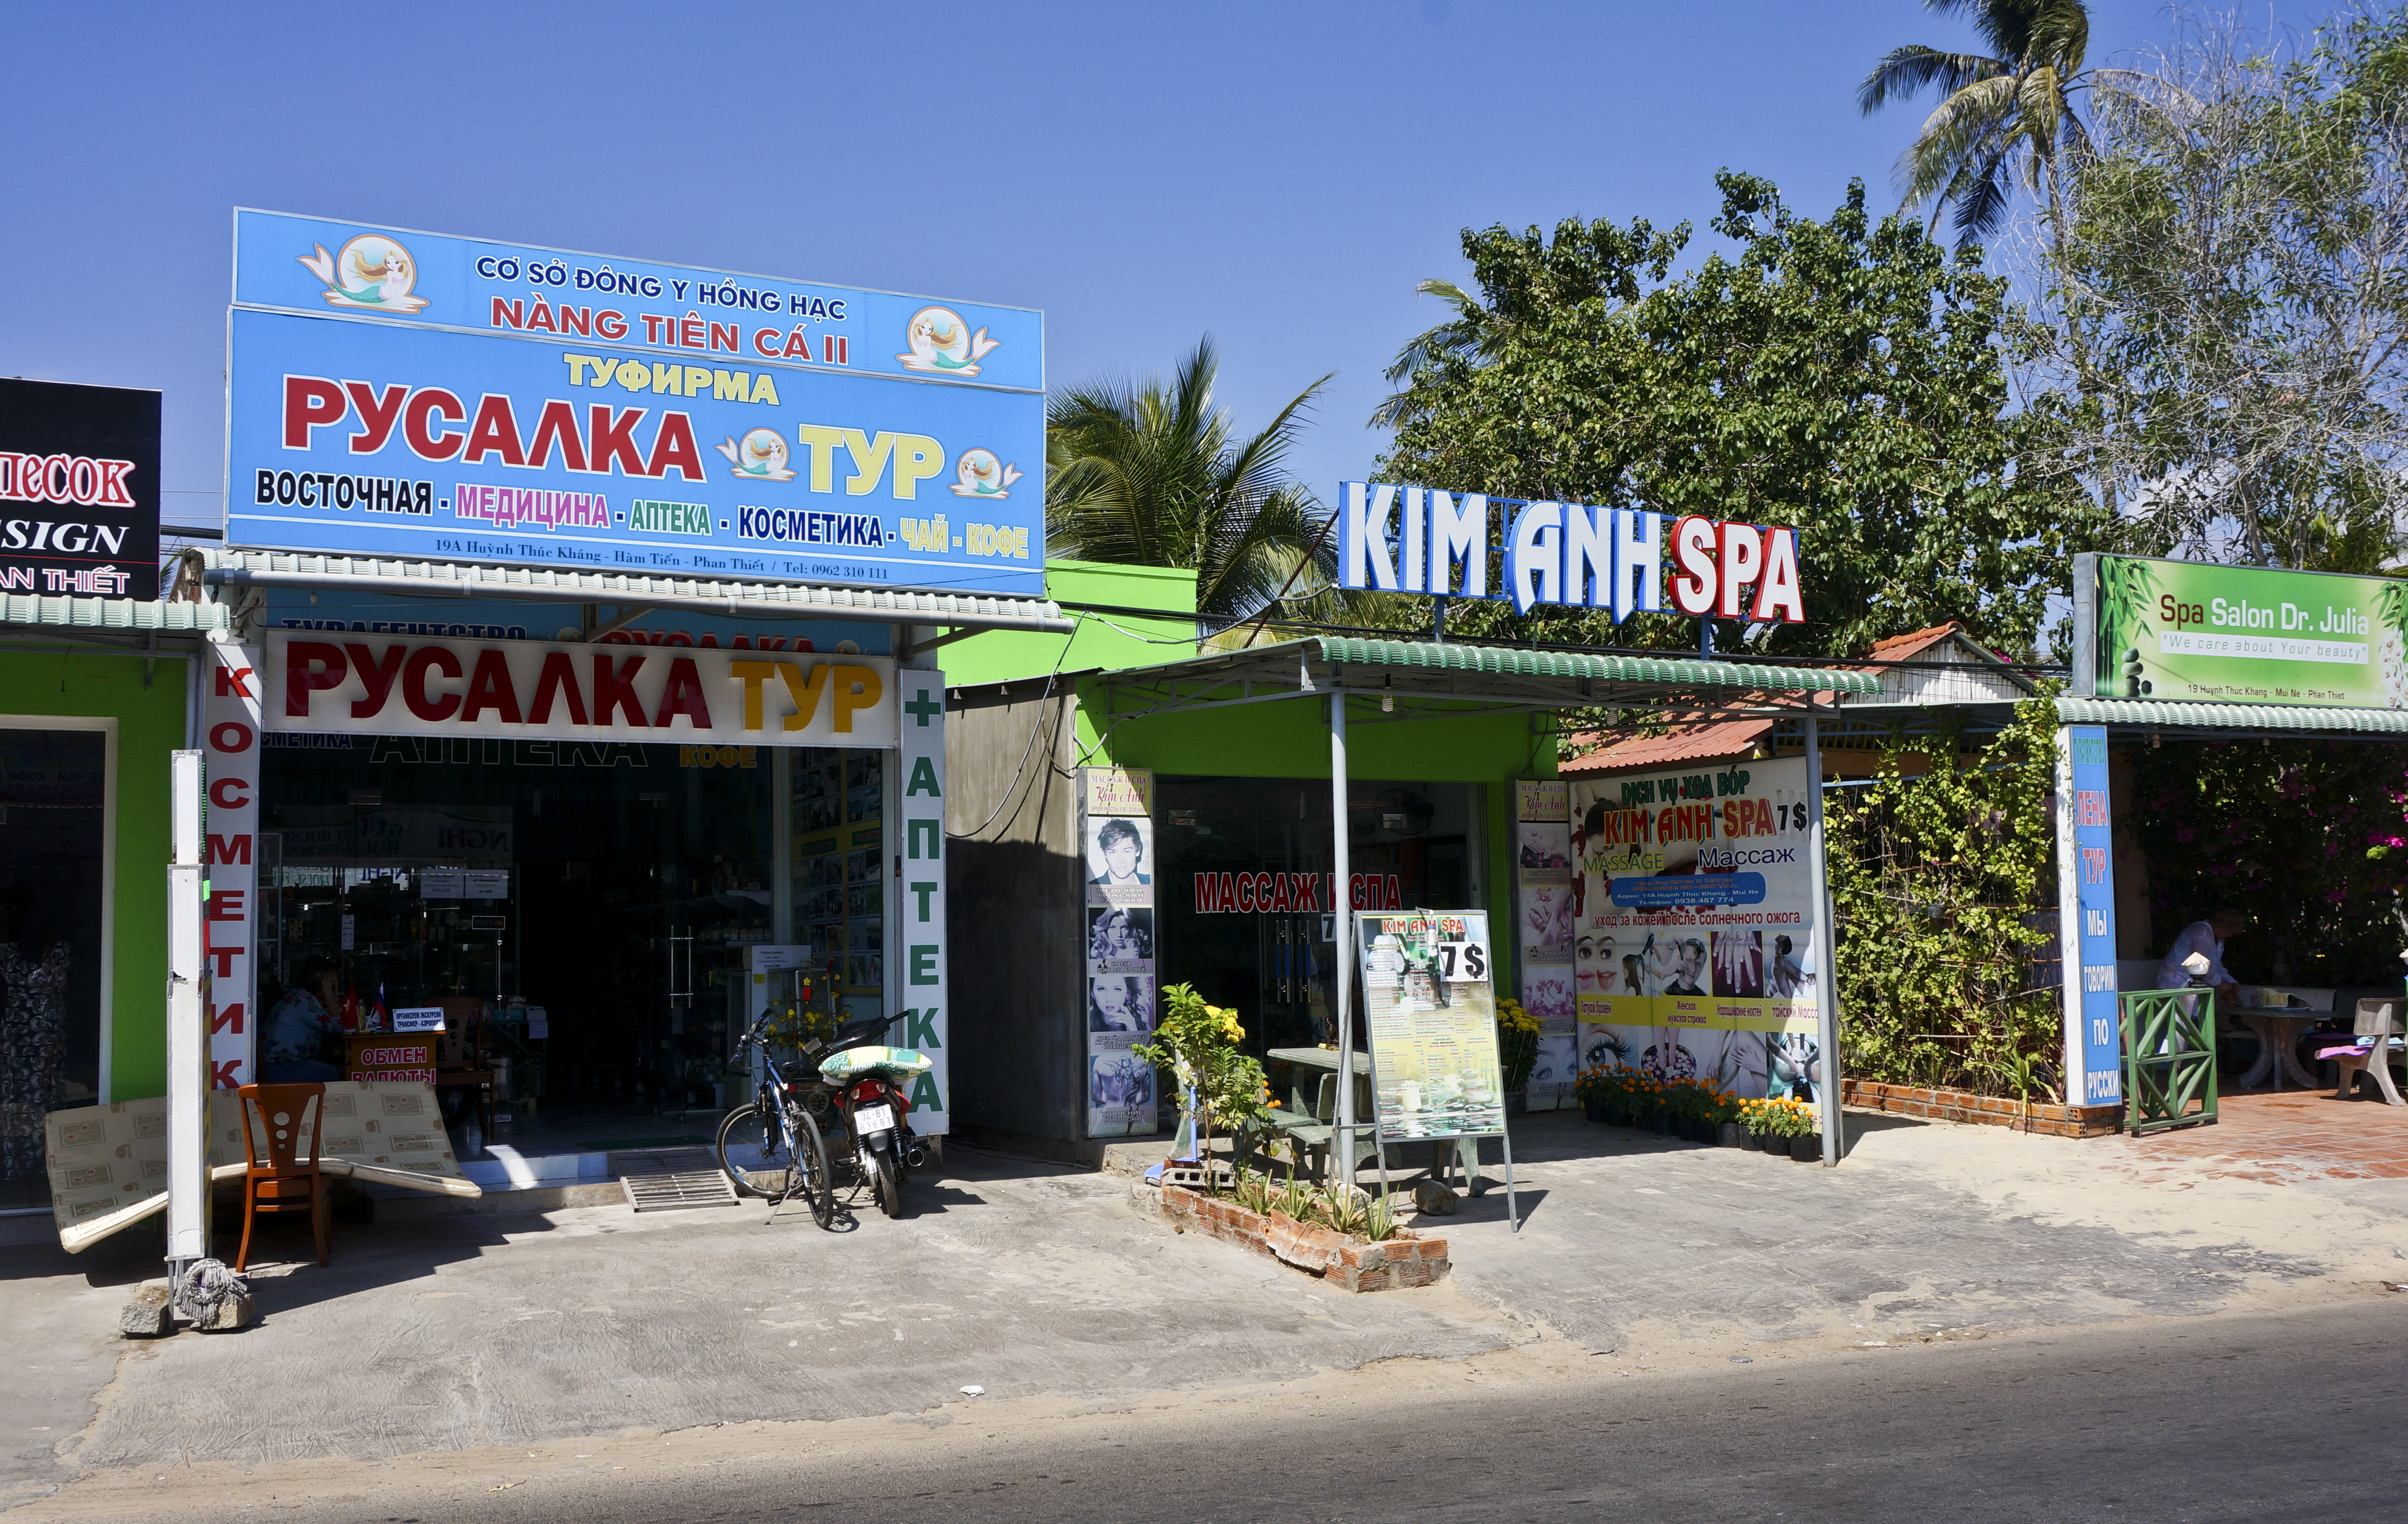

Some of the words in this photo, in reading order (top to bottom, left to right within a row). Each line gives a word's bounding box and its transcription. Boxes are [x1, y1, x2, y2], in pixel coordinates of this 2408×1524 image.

[475, 255, 520, 279] CƠ
[526, 258, 569, 286] SỞ
[572, 264, 662, 298] ĐÔNG
[670, 278, 689, 300] Y
[698, 277, 782, 313] HỒNG
[789, 294, 849, 323] HẠC
[490, 292, 630, 341] NÀNG
[639, 312, 741, 353] TIÊN
[752, 321, 812, 362] CÁ
[823, 334, 850, 366] II
[563, 353, 781, 406] ТУФИРМА
[281, 374, 707, 484] РУСАЛКА
[799, 423, 946, 501] ТУР
[254, 468, 433, 516] ВОСТОЧНАЯ
[455, 483, 611, 532] МЕДИЦИНА
[628, 498, 713, 536] АПТЕКА
[737, 505, 886, 549] КОСМЕТИКА
[900, 513, 949, 553] ЧАЙ
[966, 522, 1030, 559] КОФЕ
[0, 519, 129, 555] SIGN
[435, 538, 462, 553] 19A
[466, 540, 513, 558] Huỳnh
[518, 543, 553, 558] Thúc
[557, 545, 602, 564] Kháng
[614, 549, 646, 564] Hàm
[650, 552, 680, 567] Tiến
[694, 555, 727, 569] Phan
[730, 556, 765, 572] Thiết
[783, 561, 808, 575] Tel:
[811, 563, 840, 577] 0962
[843, 565, 866, 579] 310
[869, 566, 889, 580] 111
[1338, 480, 1488, 599] KIM
[1507, 499, 1662, 625] ANH
[1668, 514, 1806, 624] SPA
[42, 564, 130, 595] THIẾT
[2160, 594, 2204, 630] Spa
[2211, 597, 2274, 629] Salon
[2280, 602, 2313, 631] Dr.
[2319, 606, 2369, 635] Julia
[2163, 634, 2191, 648] "We
[2198, 637, 2228, 651] care
[2235, 638, 2274, 653] about
[2281, 641, 2311, 655] Your
[2316, 644, 2367, 661] beauty"
[285, 641, 713, 730] РУСАЛКА
[730, 660, 883, 734] ТУР
[2187, 684, 2198, 693] 19
[2200, 685, 2223, 696] Huynh
[2225, 686, 2242, 695] Thuc
[2244, 686, 2267, 698] Khang
[2275, 688, 2290, 697] Mui
[2291, 689, 2300, 697] Ne
[2308, 690, 2326, 699] Phan
[2327, 690, 2345, 700] Thiet
[679, 745, 758, 768] КОФЕ
[1091, 775, 1124, 784] МАССАЖ
[1125, 775, 1130, 784] И
[1131, 776, 1147, 784] СПА
[1621, 778, 1655, 809] DỊCH
[1658, 776, 1679, 806] VỤ
[1681, 774, 1713, 801] XOA
[1717, 765, 1750, 797] BÓP
[1093, 786, 1117, 803] Kim
[1120, 787, 1145, 803] Anh
[1524, 795, 1542, 810] Kim
[1545, 795, 1565, 810] Anh
[2077, 790, 2108, 826] ЛЕНА
[1604, 809, 1653, 847] KIM
[1657, 803, 1716, 847] ANH
[1723, 798, 1778, 839] SPA
[1582, 852, 1664, 875] MASSAGE
[1698, 846, 1795, 869] Массаж
[2082, 847, 2107, 884] ТУР
[206, 665, 253, 1090] КОСМЕТИК
[1194, 872, 1320, 914] МАССАЖ
[1349, 873, 1403, 912] СПА
[1382, 919, 1407, 934] KIM
[1410, 919, 1437, 934] ANH
[1441, 918, 1466, 933] SPA
[1594, 913, 1618, 930] уход
[1619, 915, 1630, 927] за
[1632, 911, 1662, 926] кожей
[1666, 912, 1696, 926] после
[1699, 912, 1763, 926] солнечного
[1766, 911, 1801, 925] ожога
[2087, 909, 2107, 937] МЫ
[2083, 965, 2114, 993] ГОВОРИМ
[1596, 1000, 1612, 1016] бровей
[1668, 1015, 1686, 1024] мужская
[1687, 1015, 1707, 1025] стрижка
[1717, 1003, 1746, 1018] Наращивание
[1772, 1003, 1796, 1018] тайский
[1798, 1004, 1818, 1019] Масса
[2093, 1018, 2109, 1046] ПО
[361, 1047, 427, 1066] ОБМЕН
[351, 1068, 436, 1085] ВАЛЮТЫ
[2087, 1069, 2119, 1099] РУССКИ
